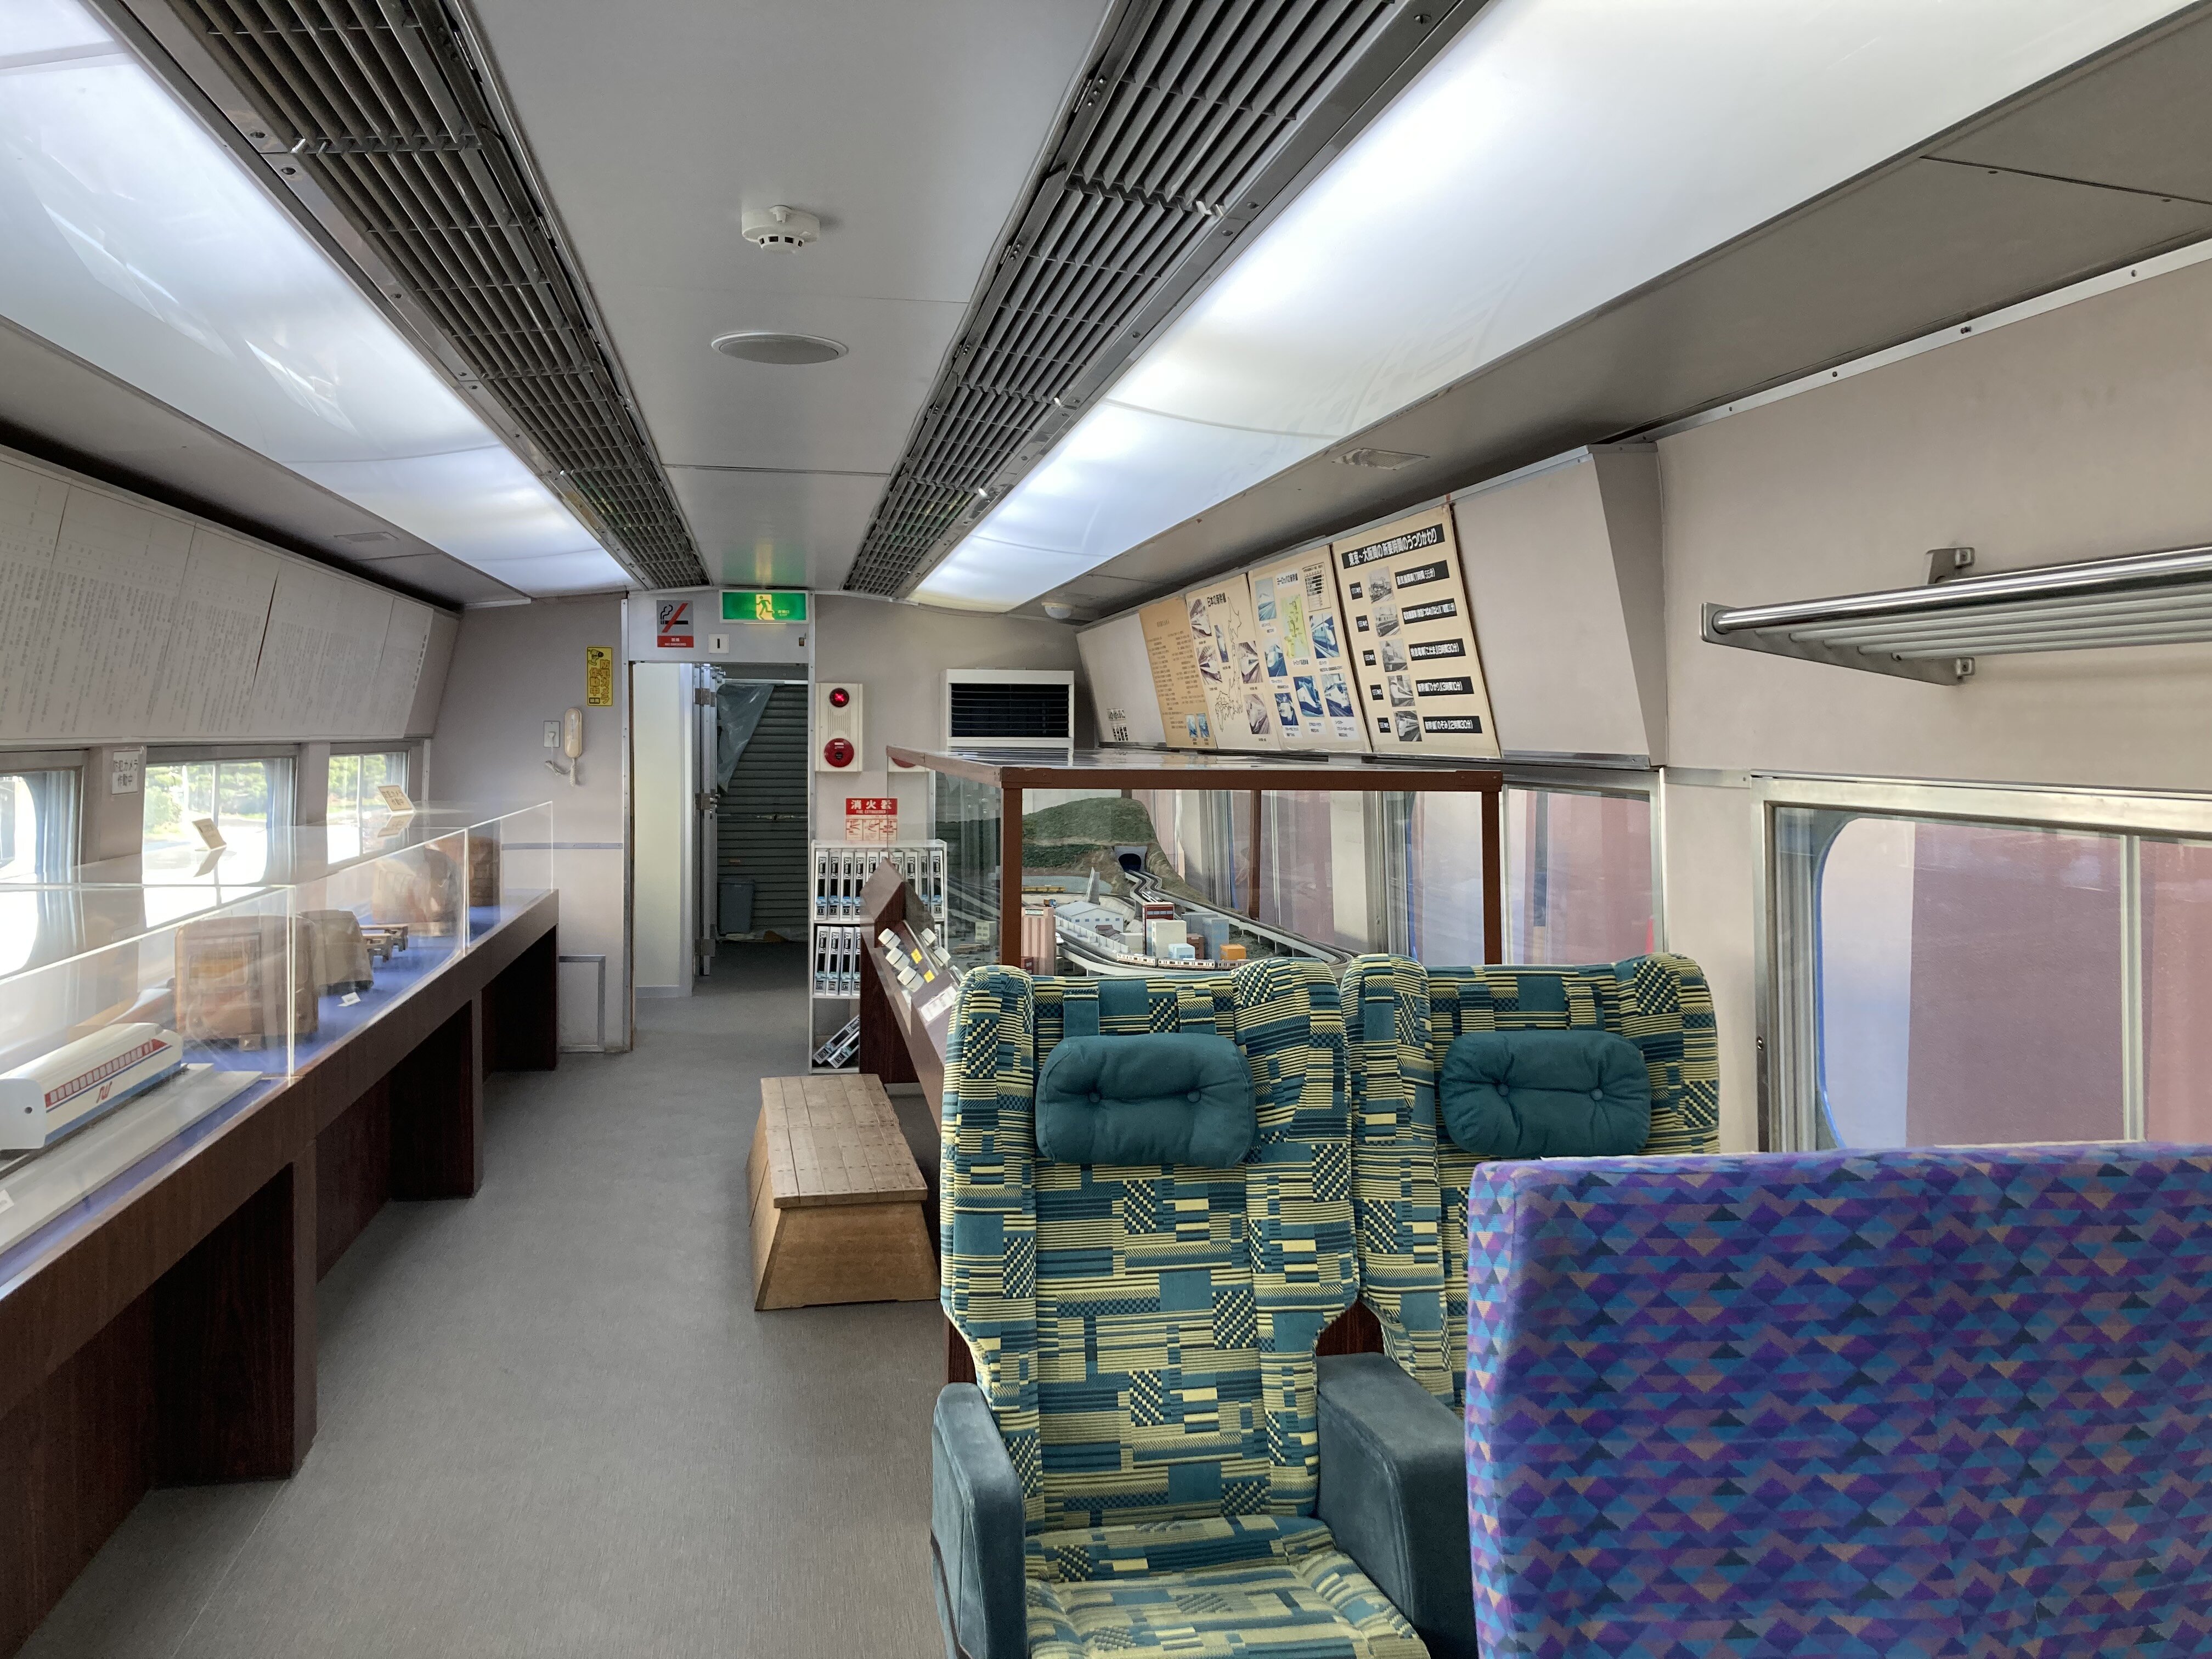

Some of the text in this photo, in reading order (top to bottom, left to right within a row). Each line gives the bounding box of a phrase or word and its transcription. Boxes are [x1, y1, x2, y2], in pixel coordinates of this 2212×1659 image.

[600, 659, 611, 704] 防犯カメラ
